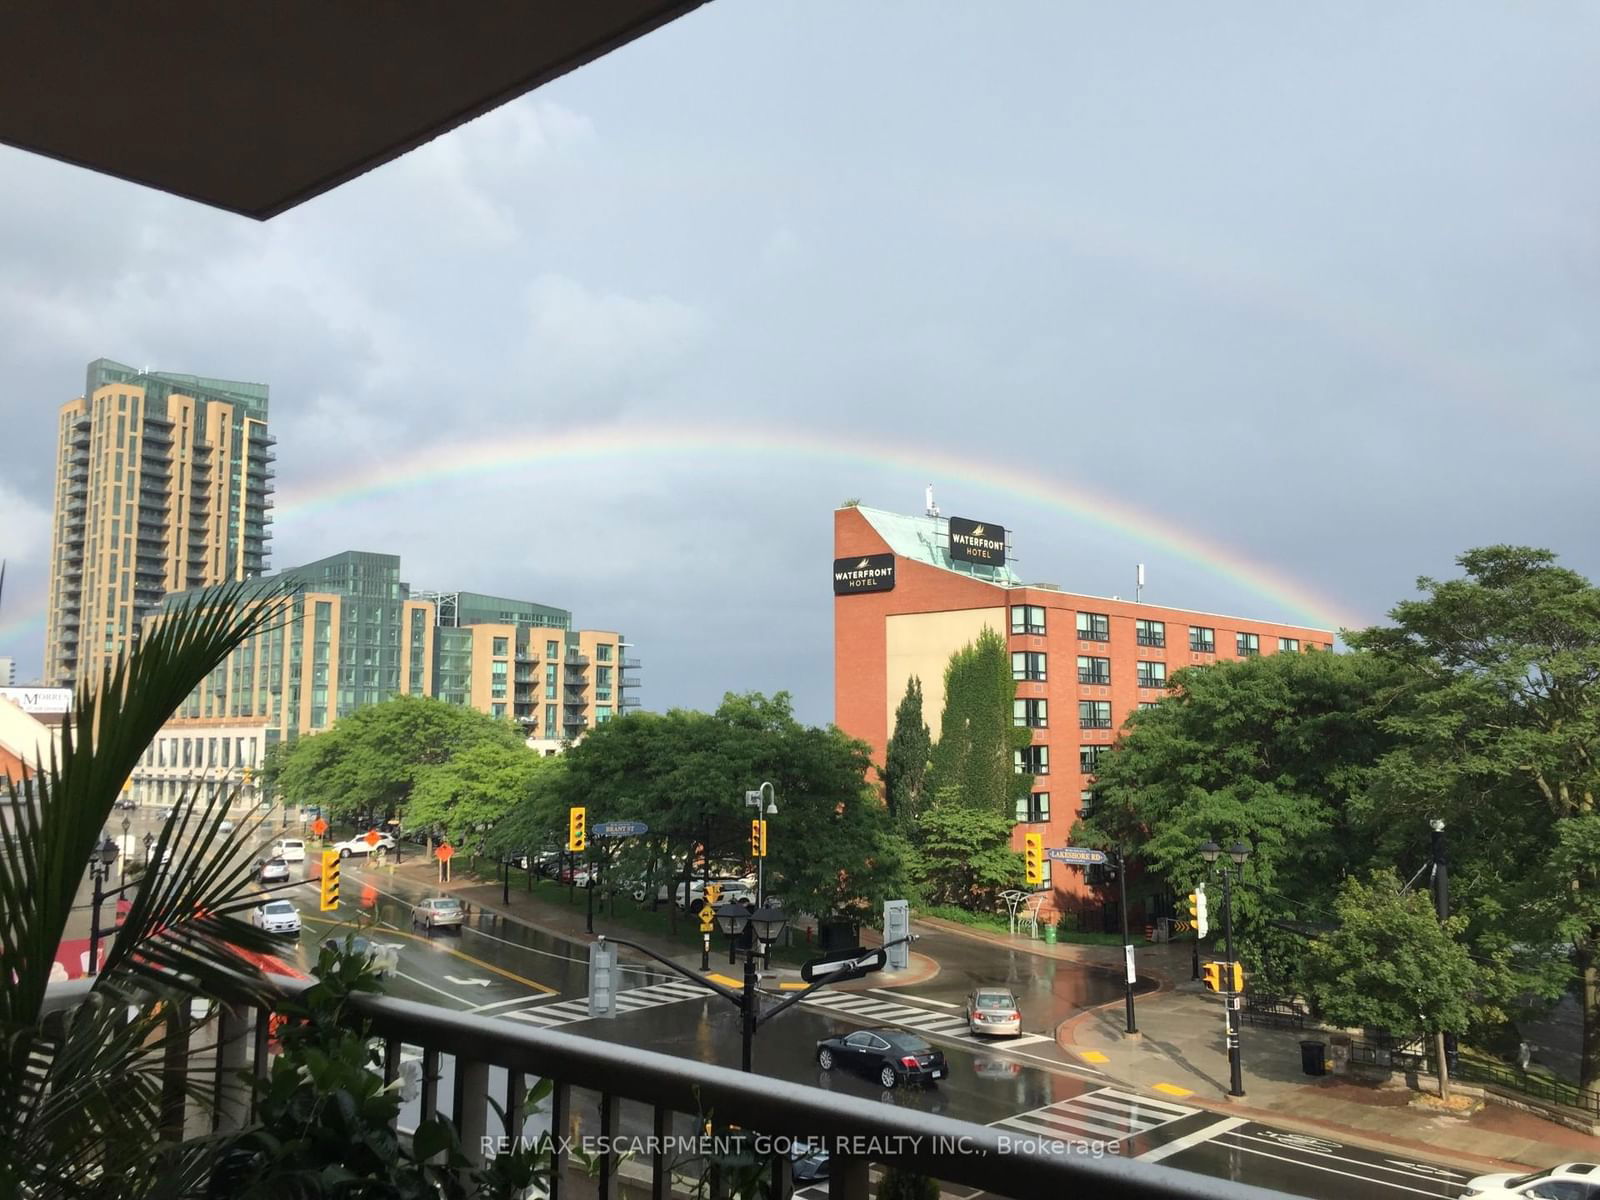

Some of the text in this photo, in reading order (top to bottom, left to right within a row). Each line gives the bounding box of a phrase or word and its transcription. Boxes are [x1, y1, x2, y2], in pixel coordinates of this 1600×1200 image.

[952, 533, 1004, 550] WATERFRONT
[966, 548, 991, 559] HOTEL
[835, 567, 892, 581] WATERFRONT
[849, 579, 878, 588] HOTEL
[1051, 851, 1090, 860] LAKESHORE
[1090, 852, 1101, 861] RD
